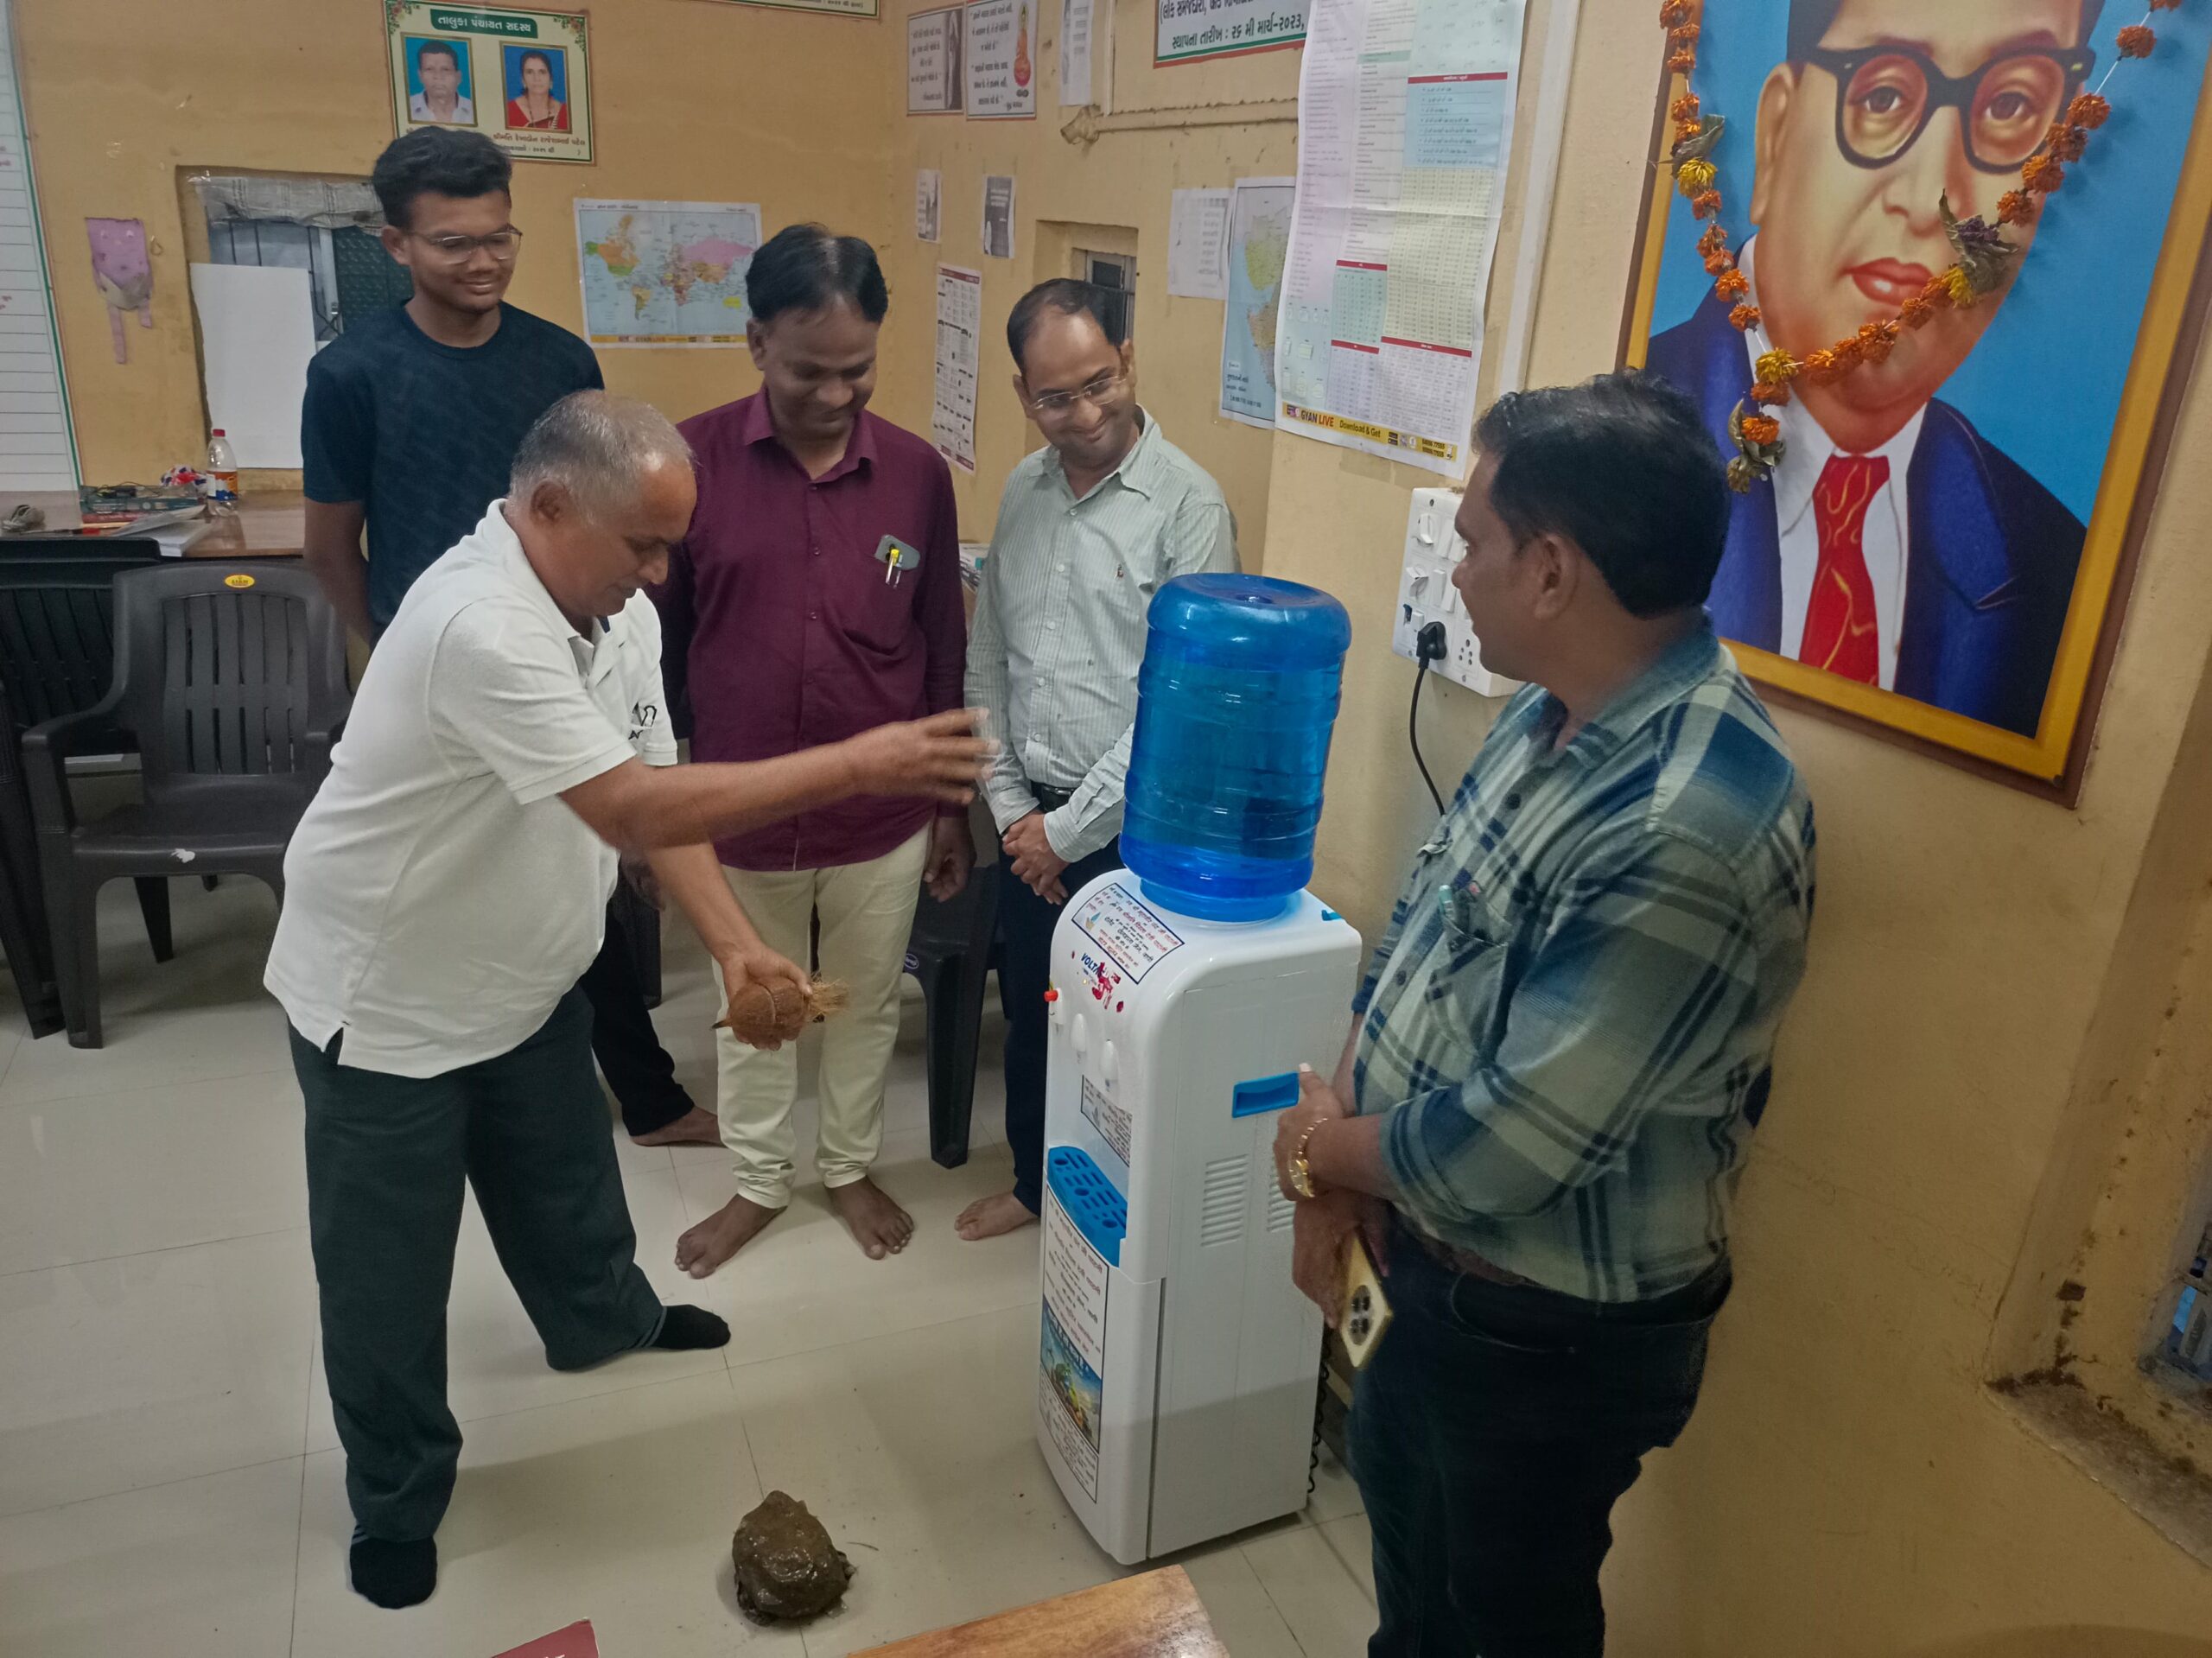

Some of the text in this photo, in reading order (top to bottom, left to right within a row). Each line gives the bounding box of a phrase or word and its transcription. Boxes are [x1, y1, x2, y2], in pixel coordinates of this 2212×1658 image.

[438, 16, 531, 32] તાલુકા પંચાયત સદસ્ય
[1173, 33, 1198, 49] સ્થાપના
[1200, 25, 1223, 45] તારીખ
[1231, 26, 1242, 39] ૨૬
[1245, 17, 1255, 37] મી
[1301, 410, 1318, 422] GYAN
[1319, 414, 1334, 427] LIVE
[1339, 420, 1365, 433] Download
[1371, 428, 1381, 437] Get
